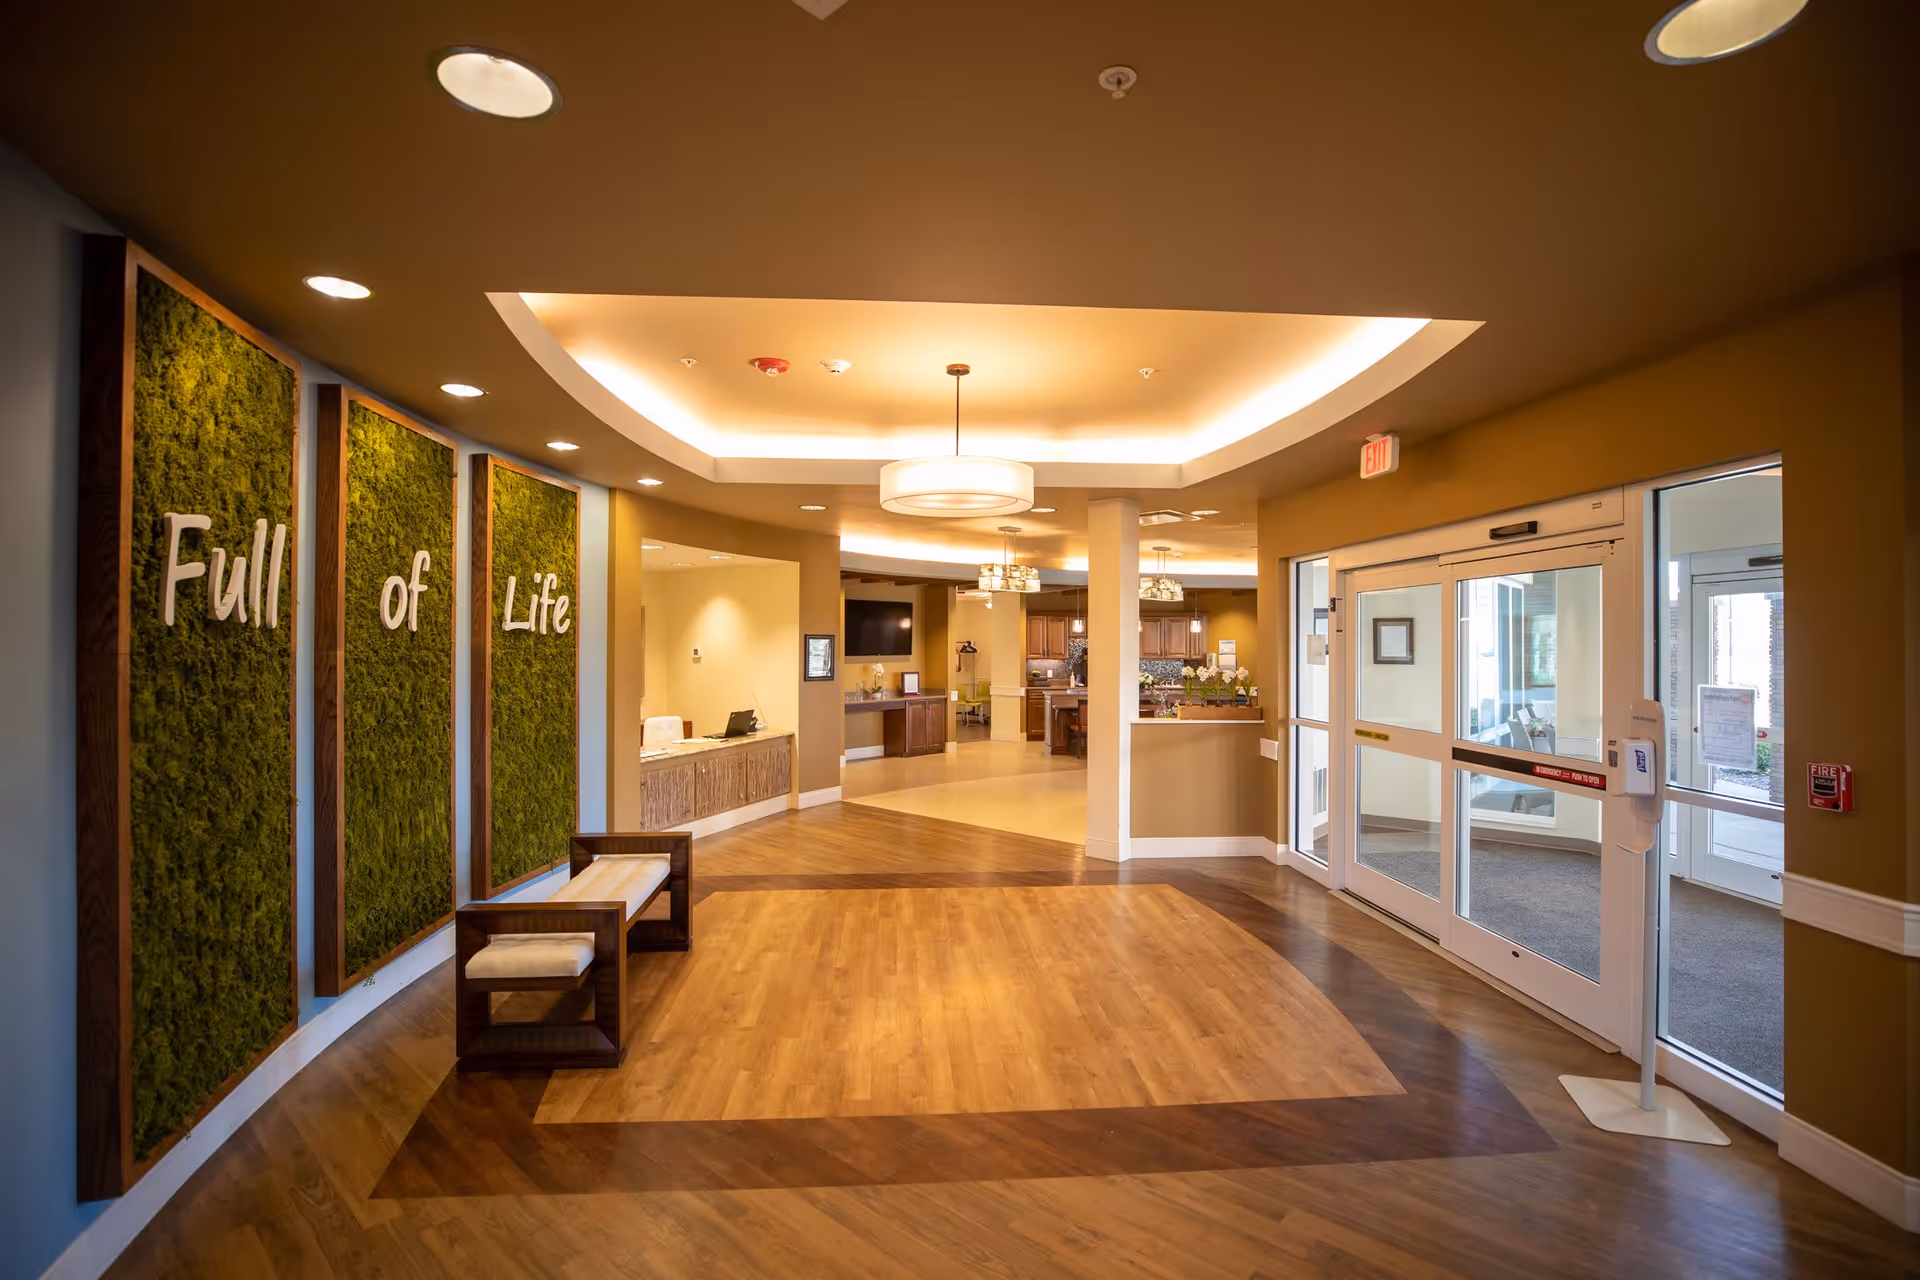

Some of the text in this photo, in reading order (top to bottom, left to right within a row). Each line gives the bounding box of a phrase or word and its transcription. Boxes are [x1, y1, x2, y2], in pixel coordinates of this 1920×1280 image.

[1365, 437, 1388, 475] EXIT
[163, 512, 571, 635] Full of Life
[1540, 766, 1561, 777] EMERGENCY
[1571, 772, 1582, 781] PUSH
[1582, 774, 1588, 782] TO
[1588, 776, 1600, 784] OPEN
[1811, 765, 1837, 777] FIRE
